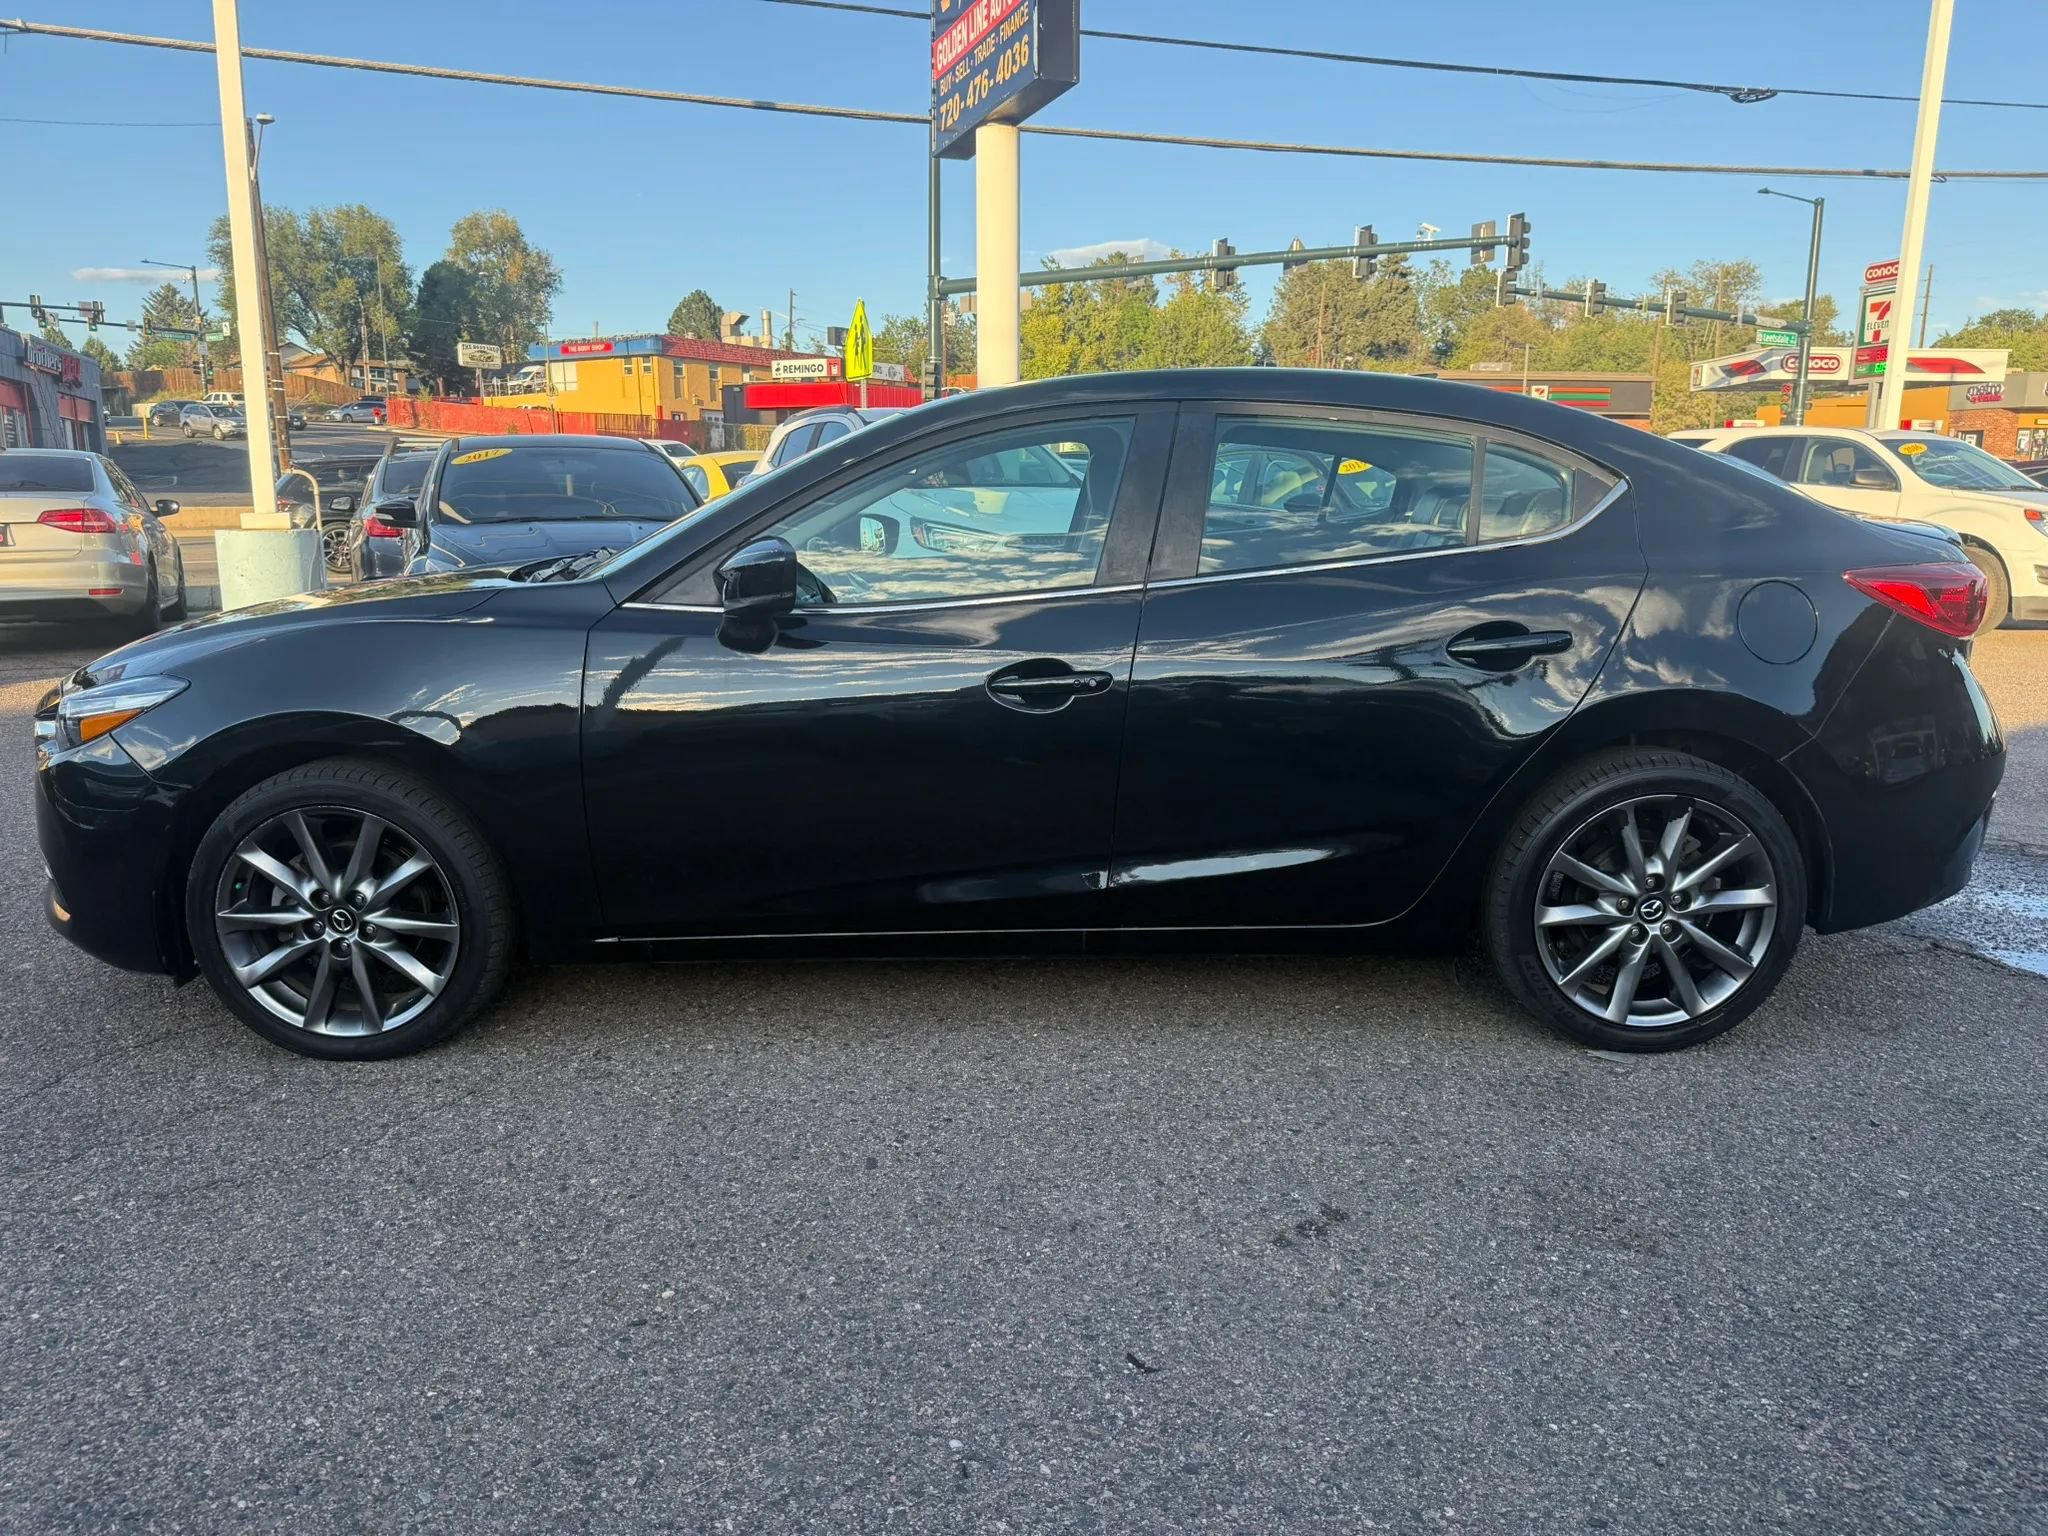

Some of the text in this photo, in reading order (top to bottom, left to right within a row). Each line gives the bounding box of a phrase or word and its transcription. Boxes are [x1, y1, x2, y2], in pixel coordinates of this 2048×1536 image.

[937, 0, 1013, 71] GOLDEN LINE AU
[940, 1, 1029, 96] BUY SELL TRADE FINANCE
[591, 343, 606, 351] SHOP
[783, 364, 824, 374] REMINGO
